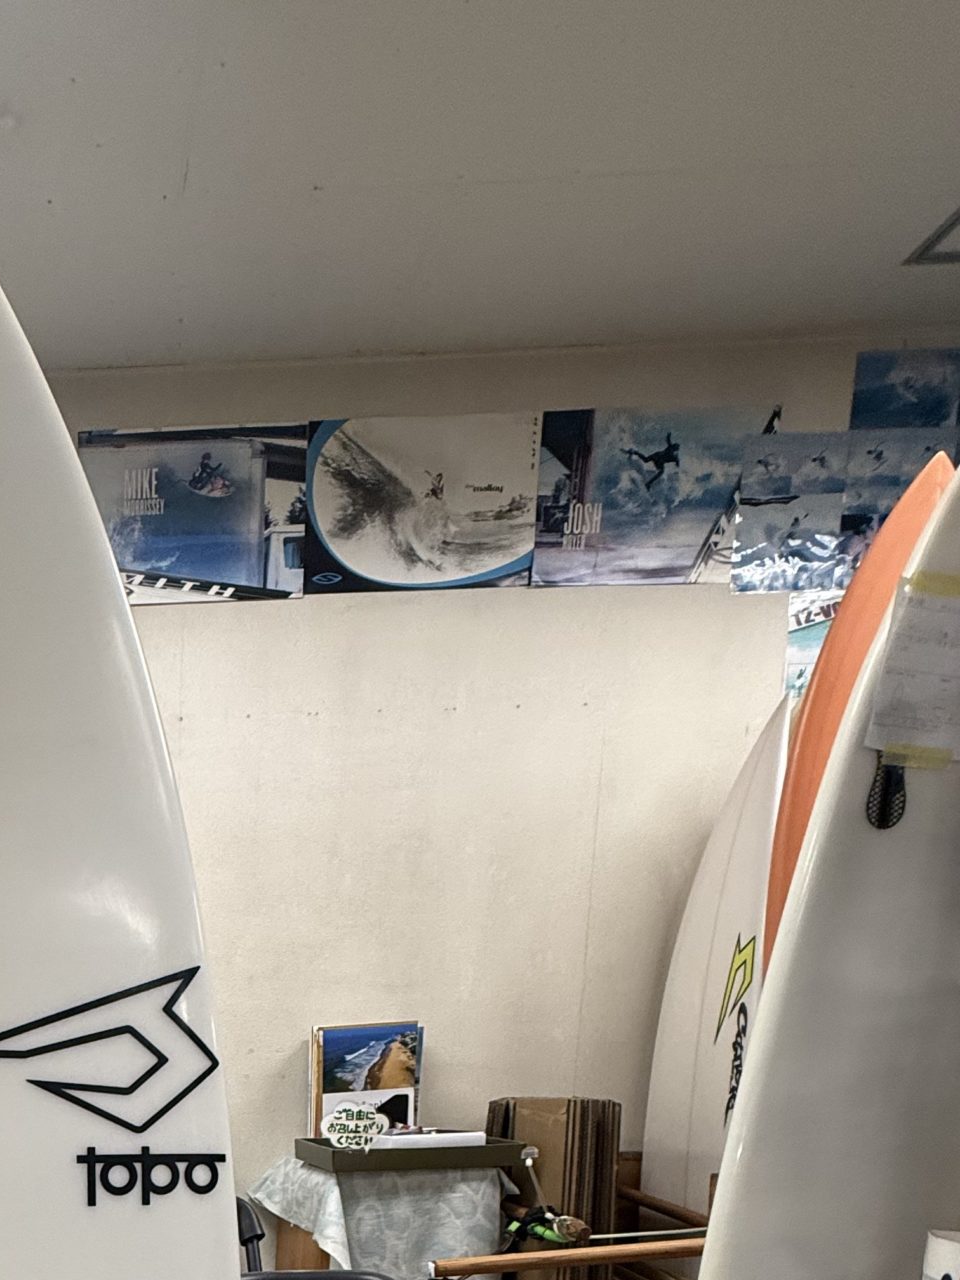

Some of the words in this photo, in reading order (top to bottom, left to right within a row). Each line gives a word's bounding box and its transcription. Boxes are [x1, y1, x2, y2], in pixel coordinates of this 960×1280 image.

[123, 467, 159, 499] MIKE
[563, 502, 603, 534] JOSH
[334, 1108, 376, 1121] ご自由に
[327, 1121, 384, 1135] お召し上がり
[336, 1135, 373, 1146] ください
